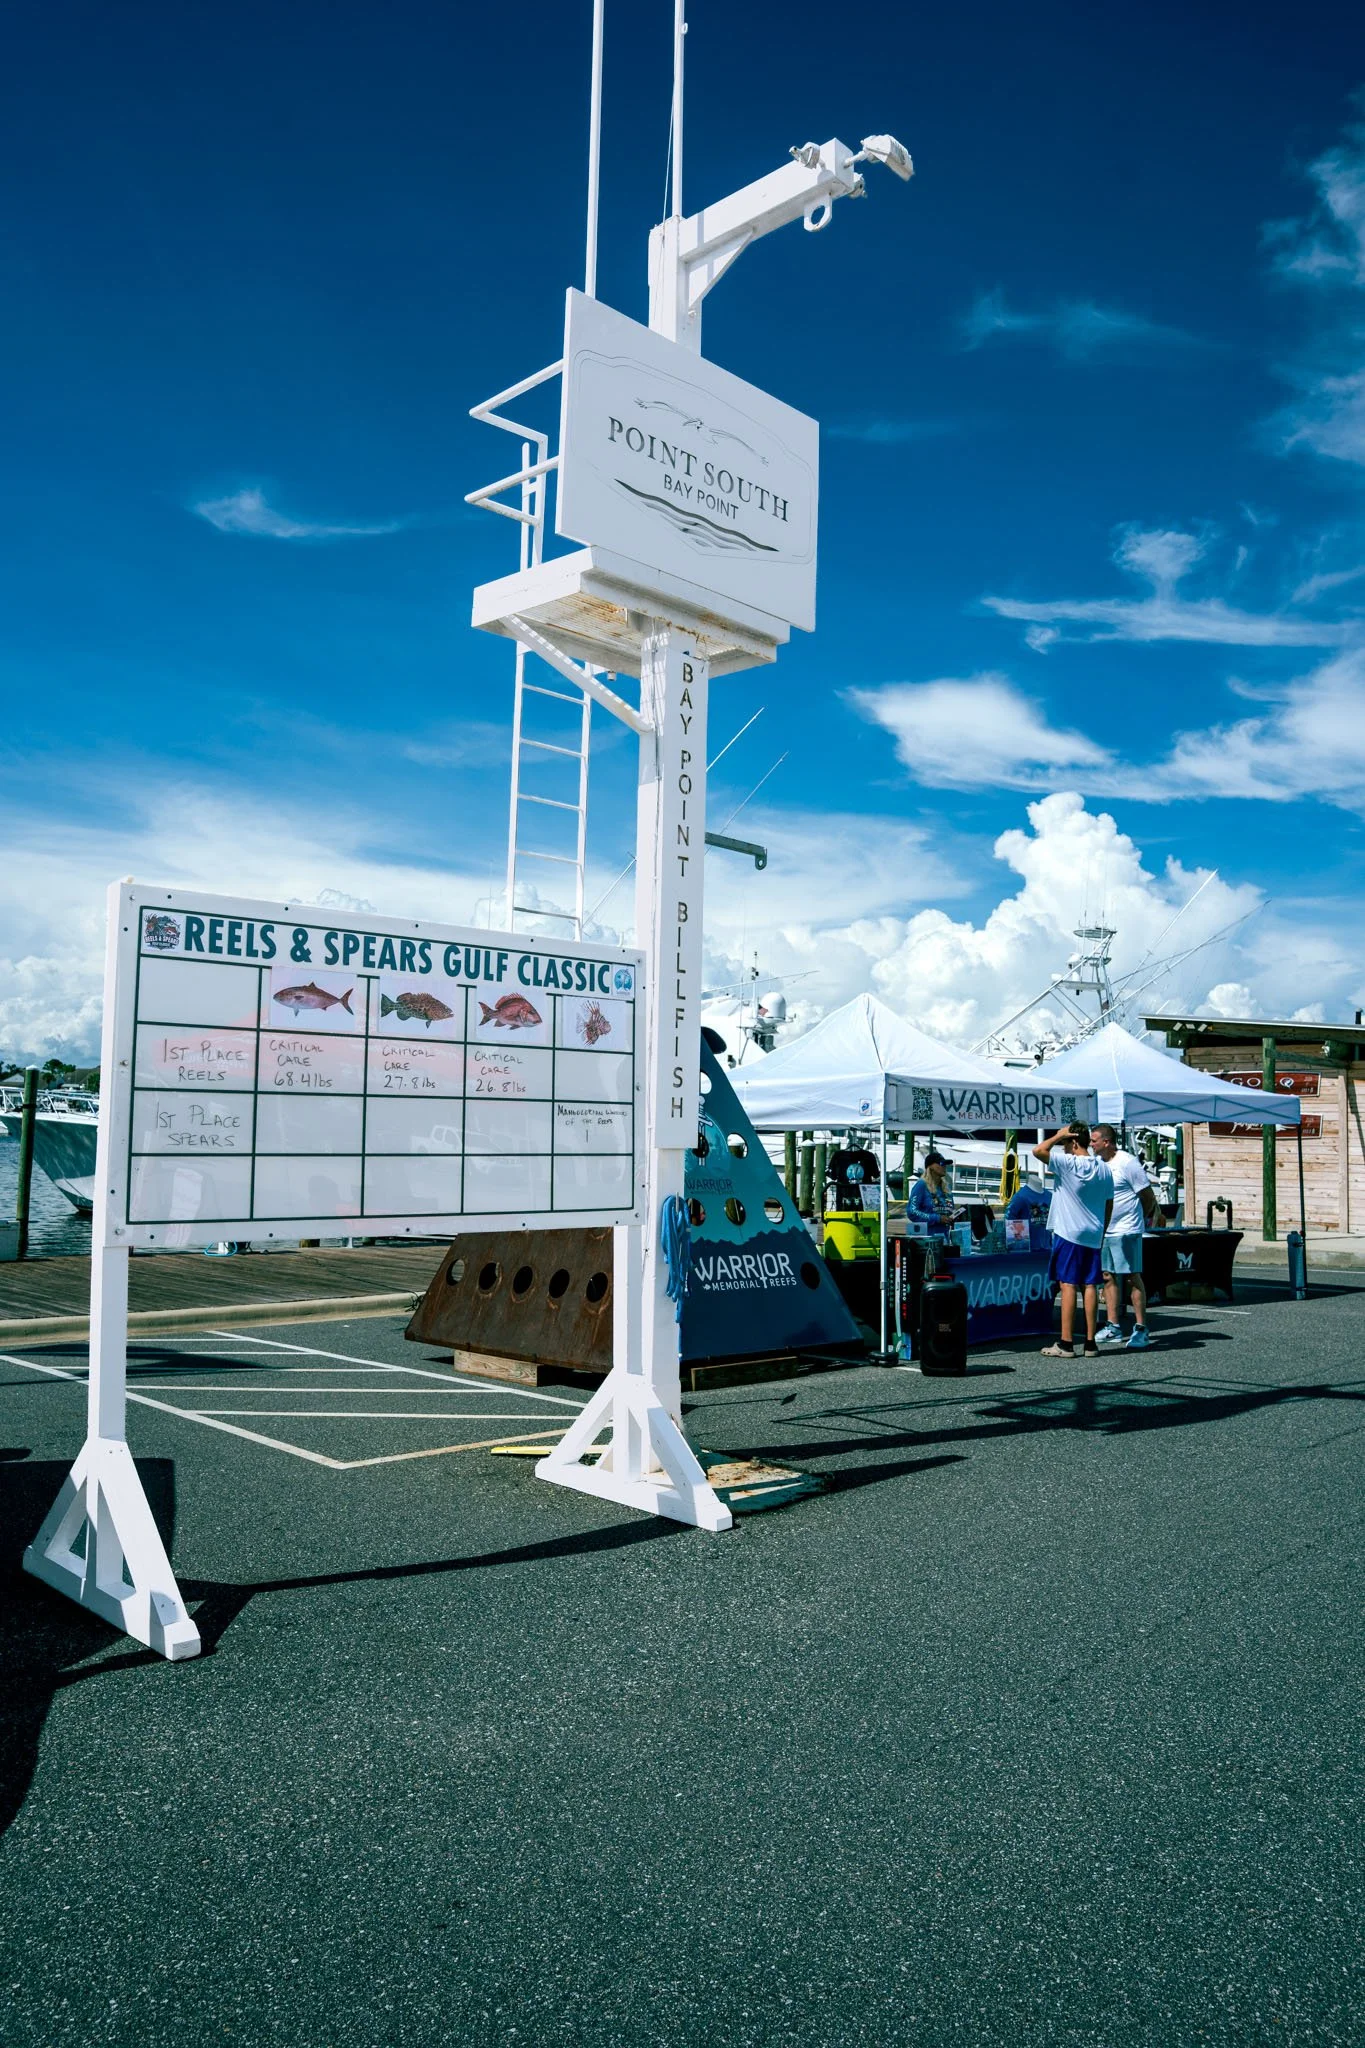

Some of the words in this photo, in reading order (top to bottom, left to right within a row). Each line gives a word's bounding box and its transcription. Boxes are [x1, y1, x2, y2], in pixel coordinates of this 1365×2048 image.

[607, 416, 698, 477] POINT
[704, 463, 789, 523] SOUTH
[664, 474, 693, 499] BAY
[697, 489, 739, 520] POINT
[680, 662, 694, 735] BAY
[677, 749, 692, 877] POINT
[184, 915, 276, 960] REELS
[290, 928, 312, 963] &
[324, 931, 432, 975] SPEARS
[443, 945, 508, 982] GULF
[518, 954, 610, 994] CLASSIC
[671, 901, 688, 1118] BILLFISH
[163, 1039, 191, 1063] 1ST
[200, 1040, 247, 1062] PLACE
[269, 1039, 324, 1053] CRITICAL
[382, 1045, 435, 1057] CRITICAL
[277, 1054, 312, 1067] CARE
[384, 1061, 411, 1071] CARE
[474, 1050, 523, 1064] CRITICAL
[178, 1066, 227, 1082] REELS
[480, 1066, 511, 1075] CARE
[938, 1087, 1056, 1120] WARRIOR
[156, 1102, 177, 1128] 1ST
[188, 1104, 241, 1128] PLACE
[958, 1111, 1016, 1121] MEMORIAL
[1027, 1114, 1057, 1122] REEFS
[168, 1133, 235, 1147] SPEARS
[695, 1252, 794, 1284] WARRIOR
[712, 1281, 760, 1291] MEMORIAL
[769, 1276, 797, 1287] REEFS
